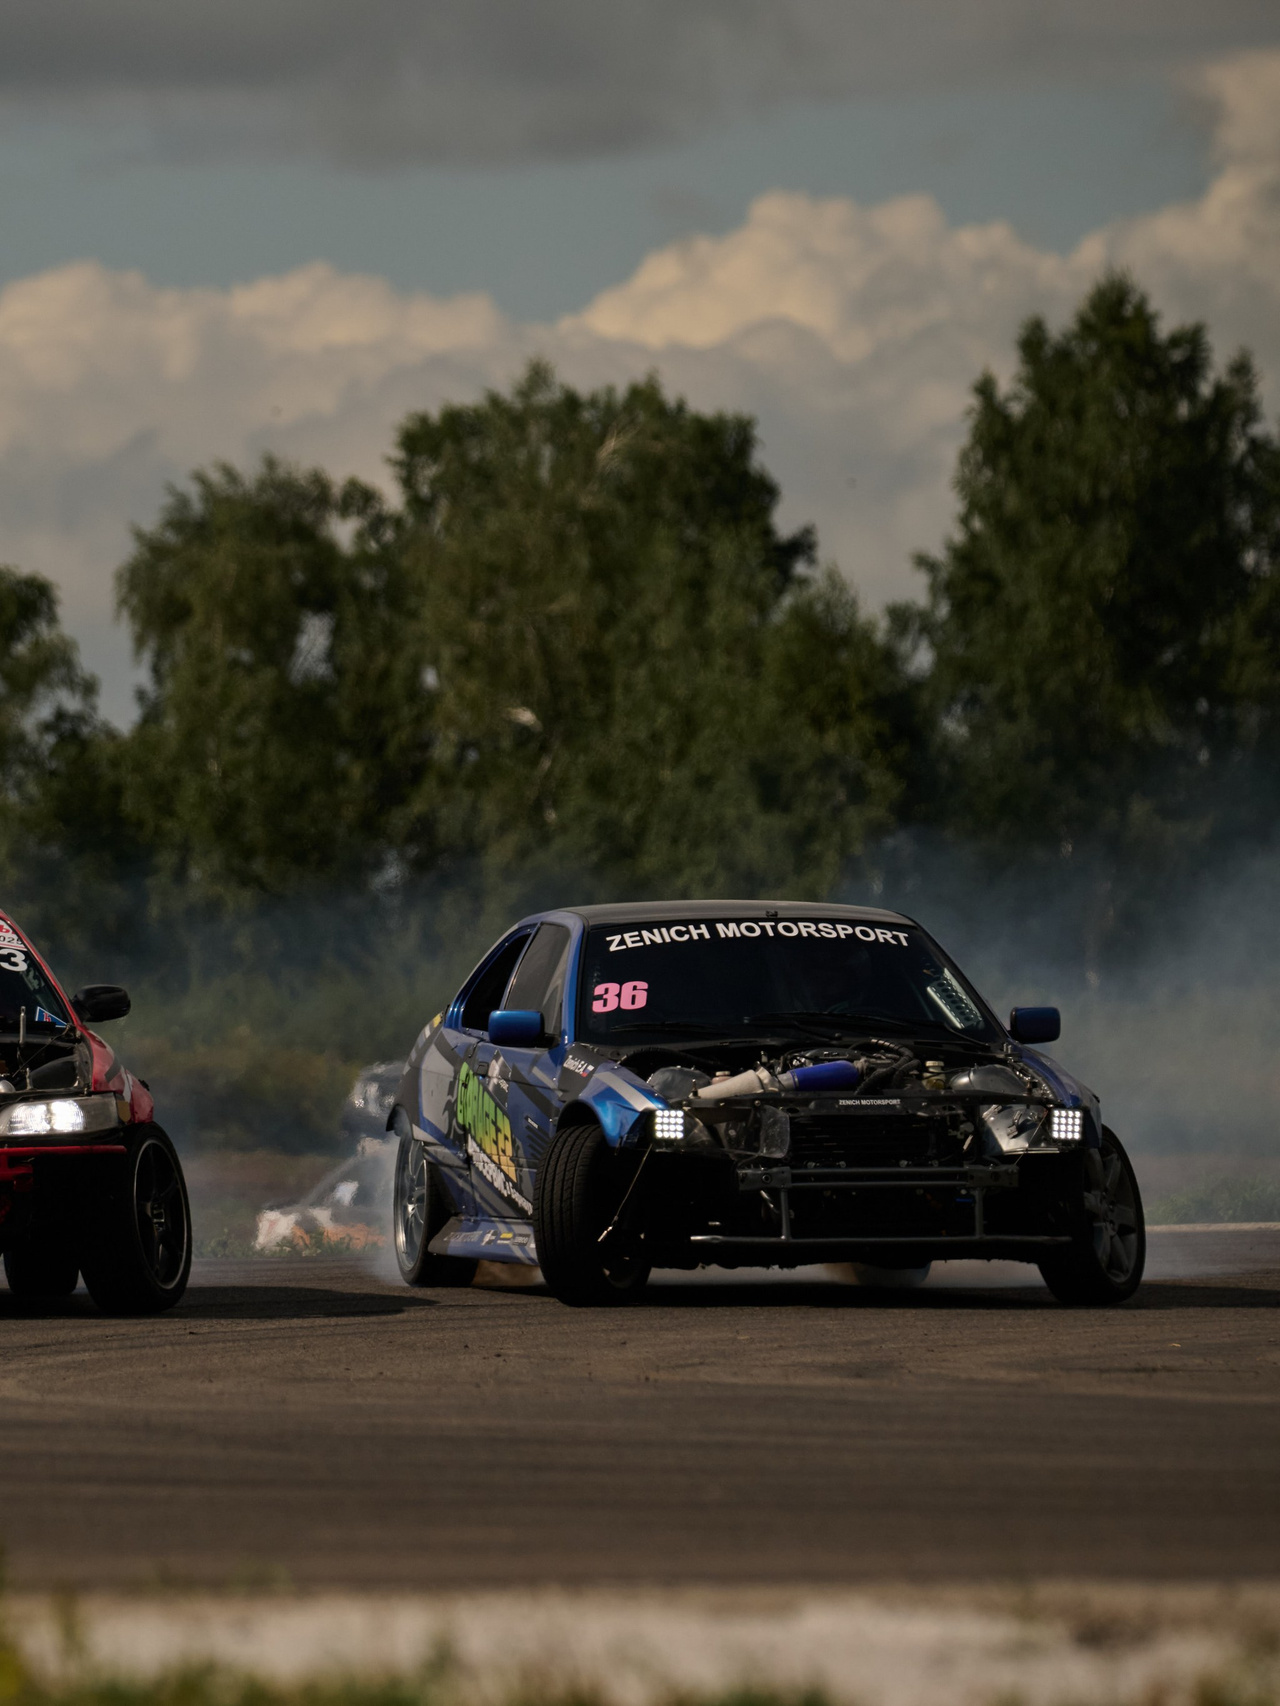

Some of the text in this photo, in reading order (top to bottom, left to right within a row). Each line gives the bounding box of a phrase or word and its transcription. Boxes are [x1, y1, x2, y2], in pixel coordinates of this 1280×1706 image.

[605, 922, 908, 952] ZENICH MOTORSPORT
[592, 981, 649, 1013] 36
